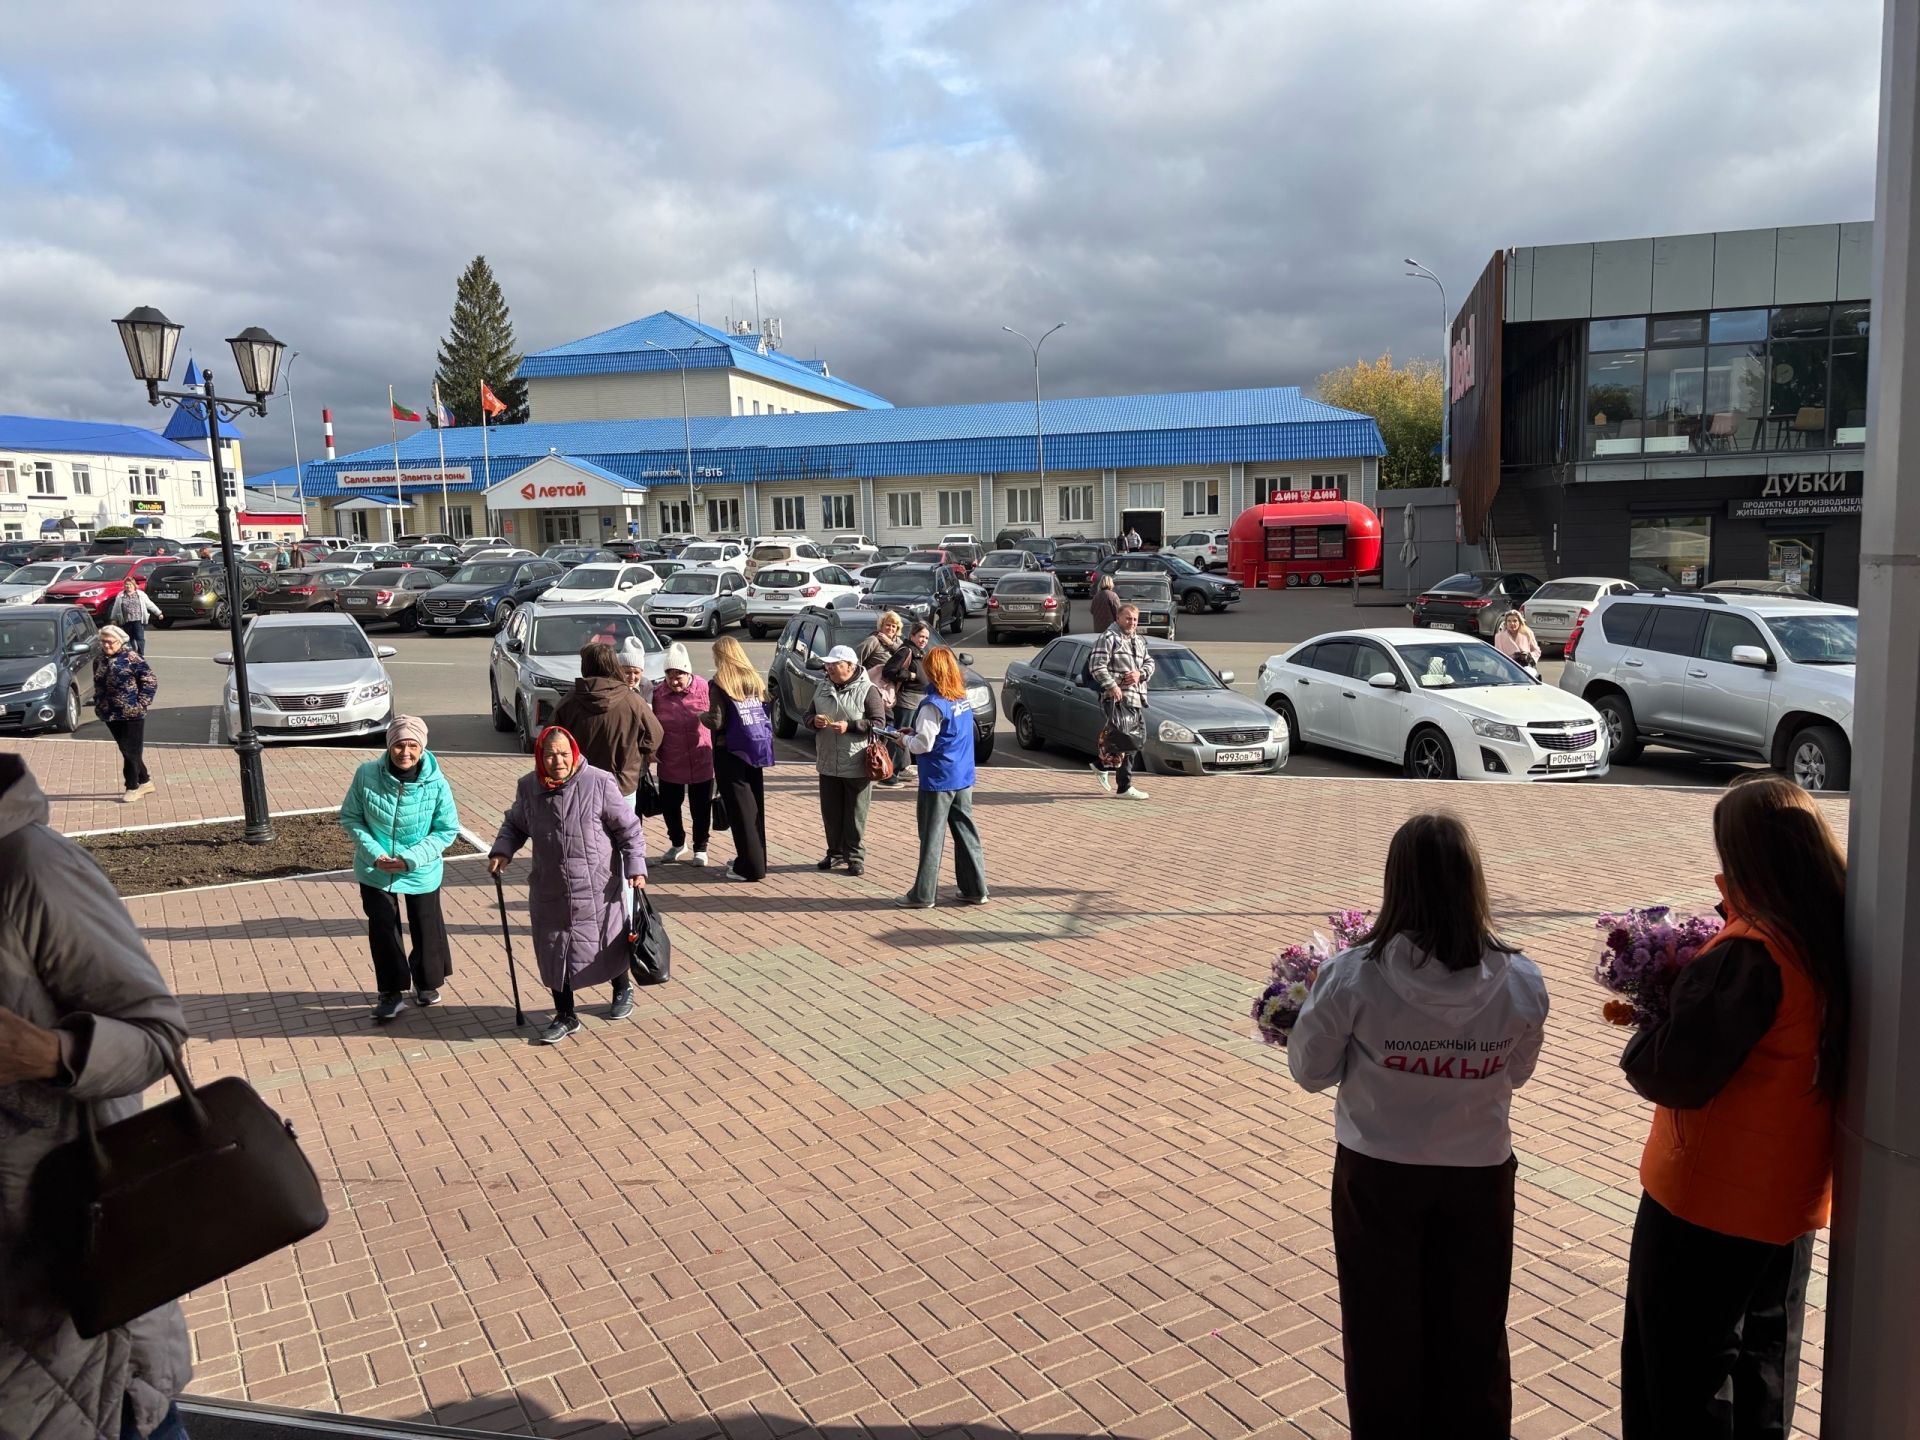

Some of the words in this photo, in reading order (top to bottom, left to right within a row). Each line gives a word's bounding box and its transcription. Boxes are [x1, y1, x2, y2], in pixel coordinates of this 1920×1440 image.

[705, 468, 723, 477] ВТБ
[343, 475, 370, 484] Салон
[372, 475, 396, 483] связи
[1761, 473, 1847, 497] ДУБКИ
[1274, 492, 1298, 501] ДИН
[1312, 490, 1337, 500] ДИН
[1742, 501, 1786, 509] ПРОДУКТЫ
[1787, 500, 1797, 508] ОТ
[1811, 505, 1863, 513] АШАМЛЫКЛ
[1384, 1039, 1477, 1052] МОЛОДЕЖНЫЙ
